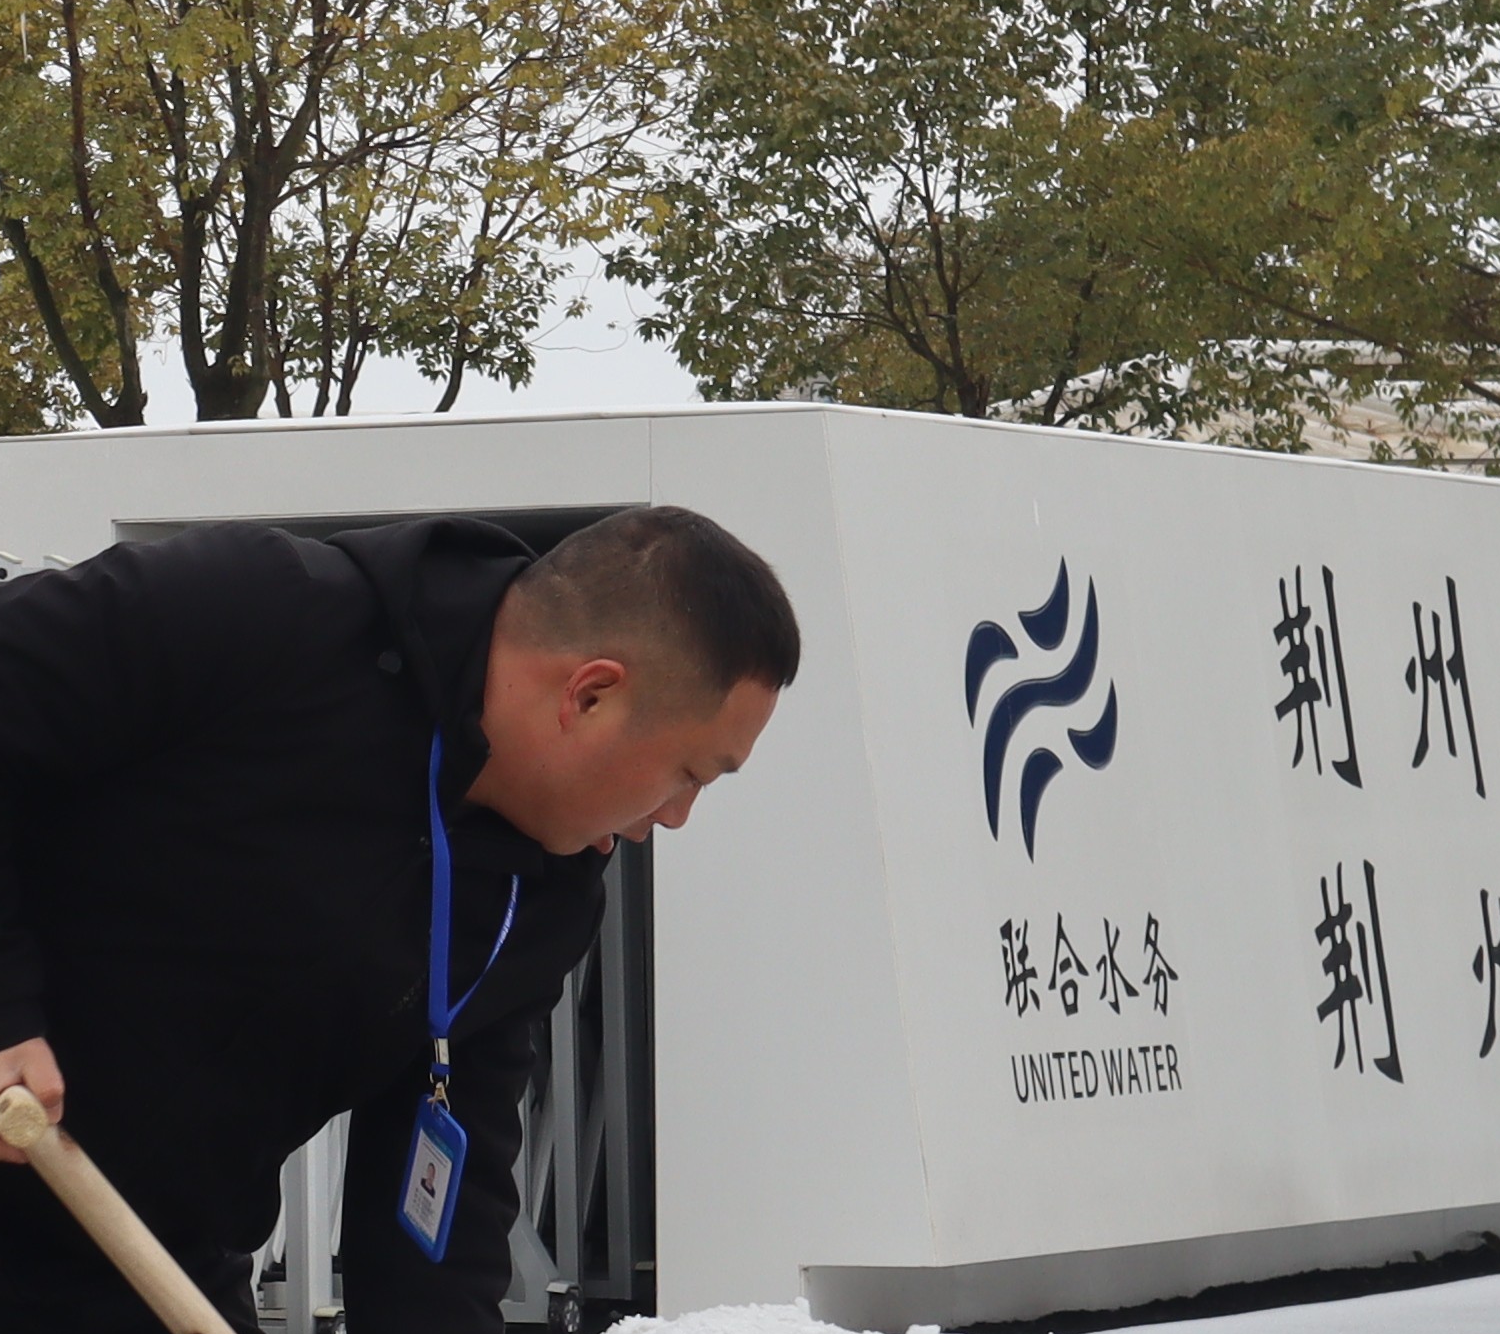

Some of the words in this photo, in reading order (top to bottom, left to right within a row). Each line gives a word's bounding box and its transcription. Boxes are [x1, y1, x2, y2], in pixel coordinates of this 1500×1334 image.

[999, 912, 1179, 1018] 联合水务
[1011, 1049, 1099, 1104] UNITED
[1101, 1044, 1183, 1097] WATER
